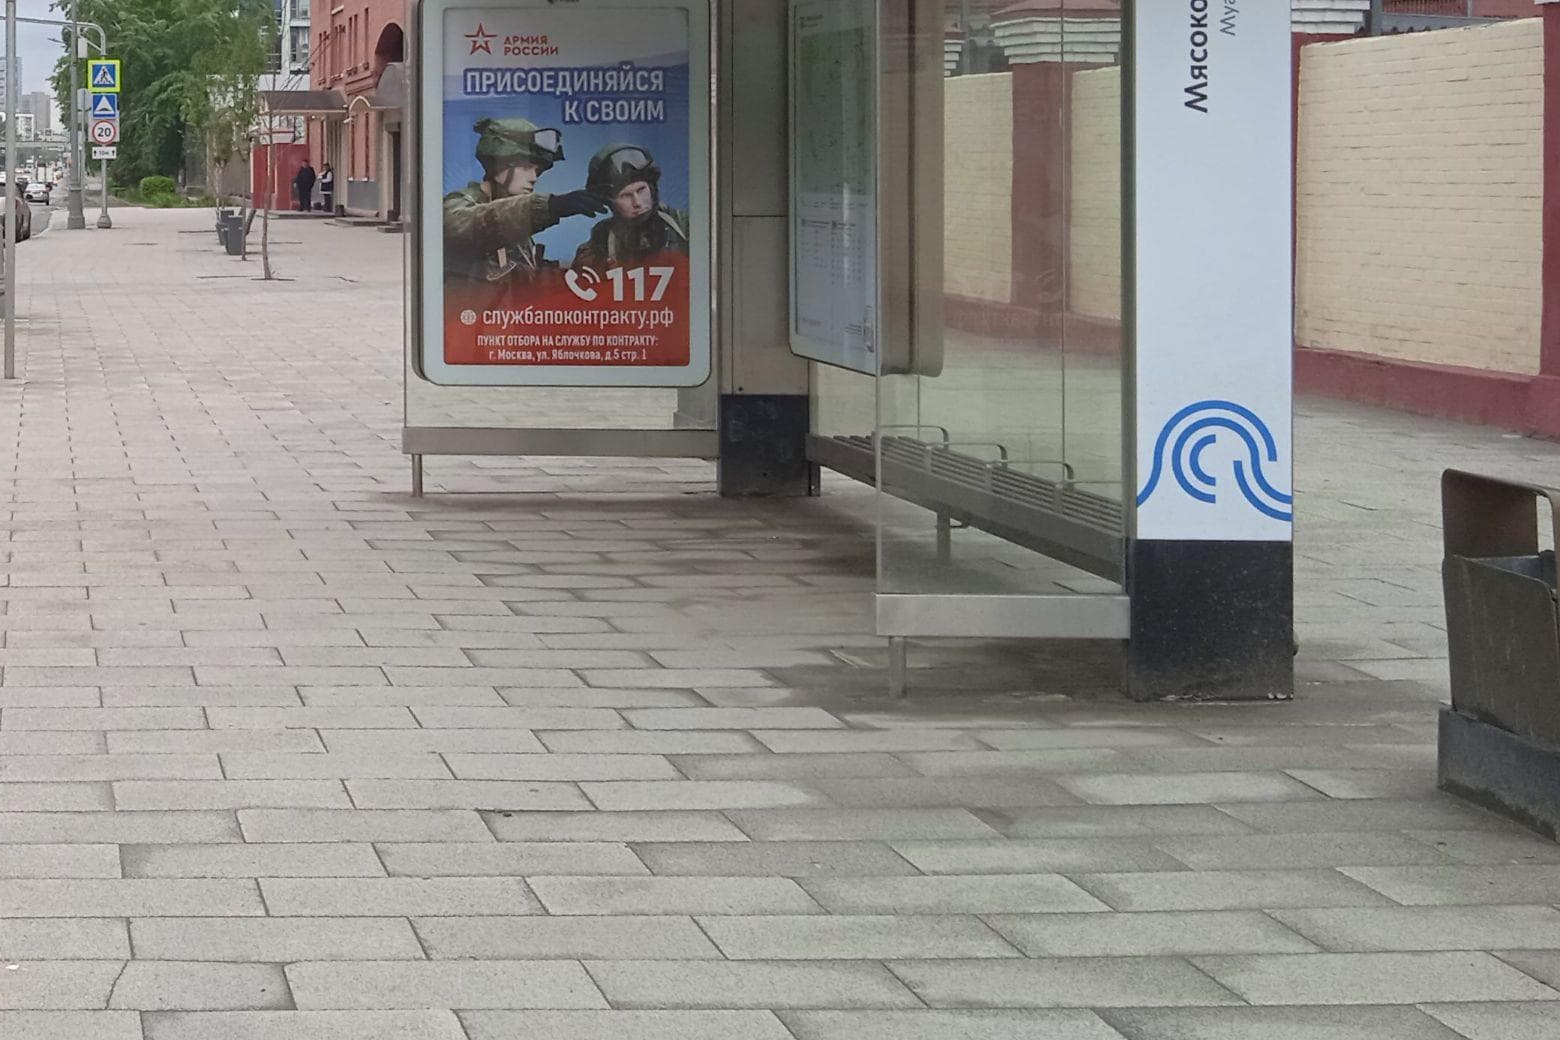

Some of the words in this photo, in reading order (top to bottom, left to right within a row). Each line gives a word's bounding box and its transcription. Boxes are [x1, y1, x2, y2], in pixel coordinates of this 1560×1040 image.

[504, 35, 548, 45] АРМИЯ
[504, 46, 559, 56] РОССИИ
[466, 65, 664, 95] ПРИСОЕДИНЯЙСЯ
[565, 101, 580, 122] К
[587, 100, 664, 121] СВОИМ
[97, 127, 111, 137] 20
[606, 267, 675, 301] 117
[483, 306, 674, 329] службапоконтракту.рф
[477, 335, 506, 346] ПУНКТ
[507, 335, 540, 346] ОТБОРА
[542, 335, 554, 346] НА
[555, 335, 591, 346] СЛУЖБУ
[592, 335, 605, 346] ПО
[606, 335, 659, 346] КОНТРАКТУ:
[489, 350, 496, 360] г.
[498, 349, 535, 361] Москва,
[536, 351, 550, 361] ул.
[551, 349, 603, 361] Яблочкова,
[621, 351, 639, 361] стр.
[642, 349, 647, 360] 1
